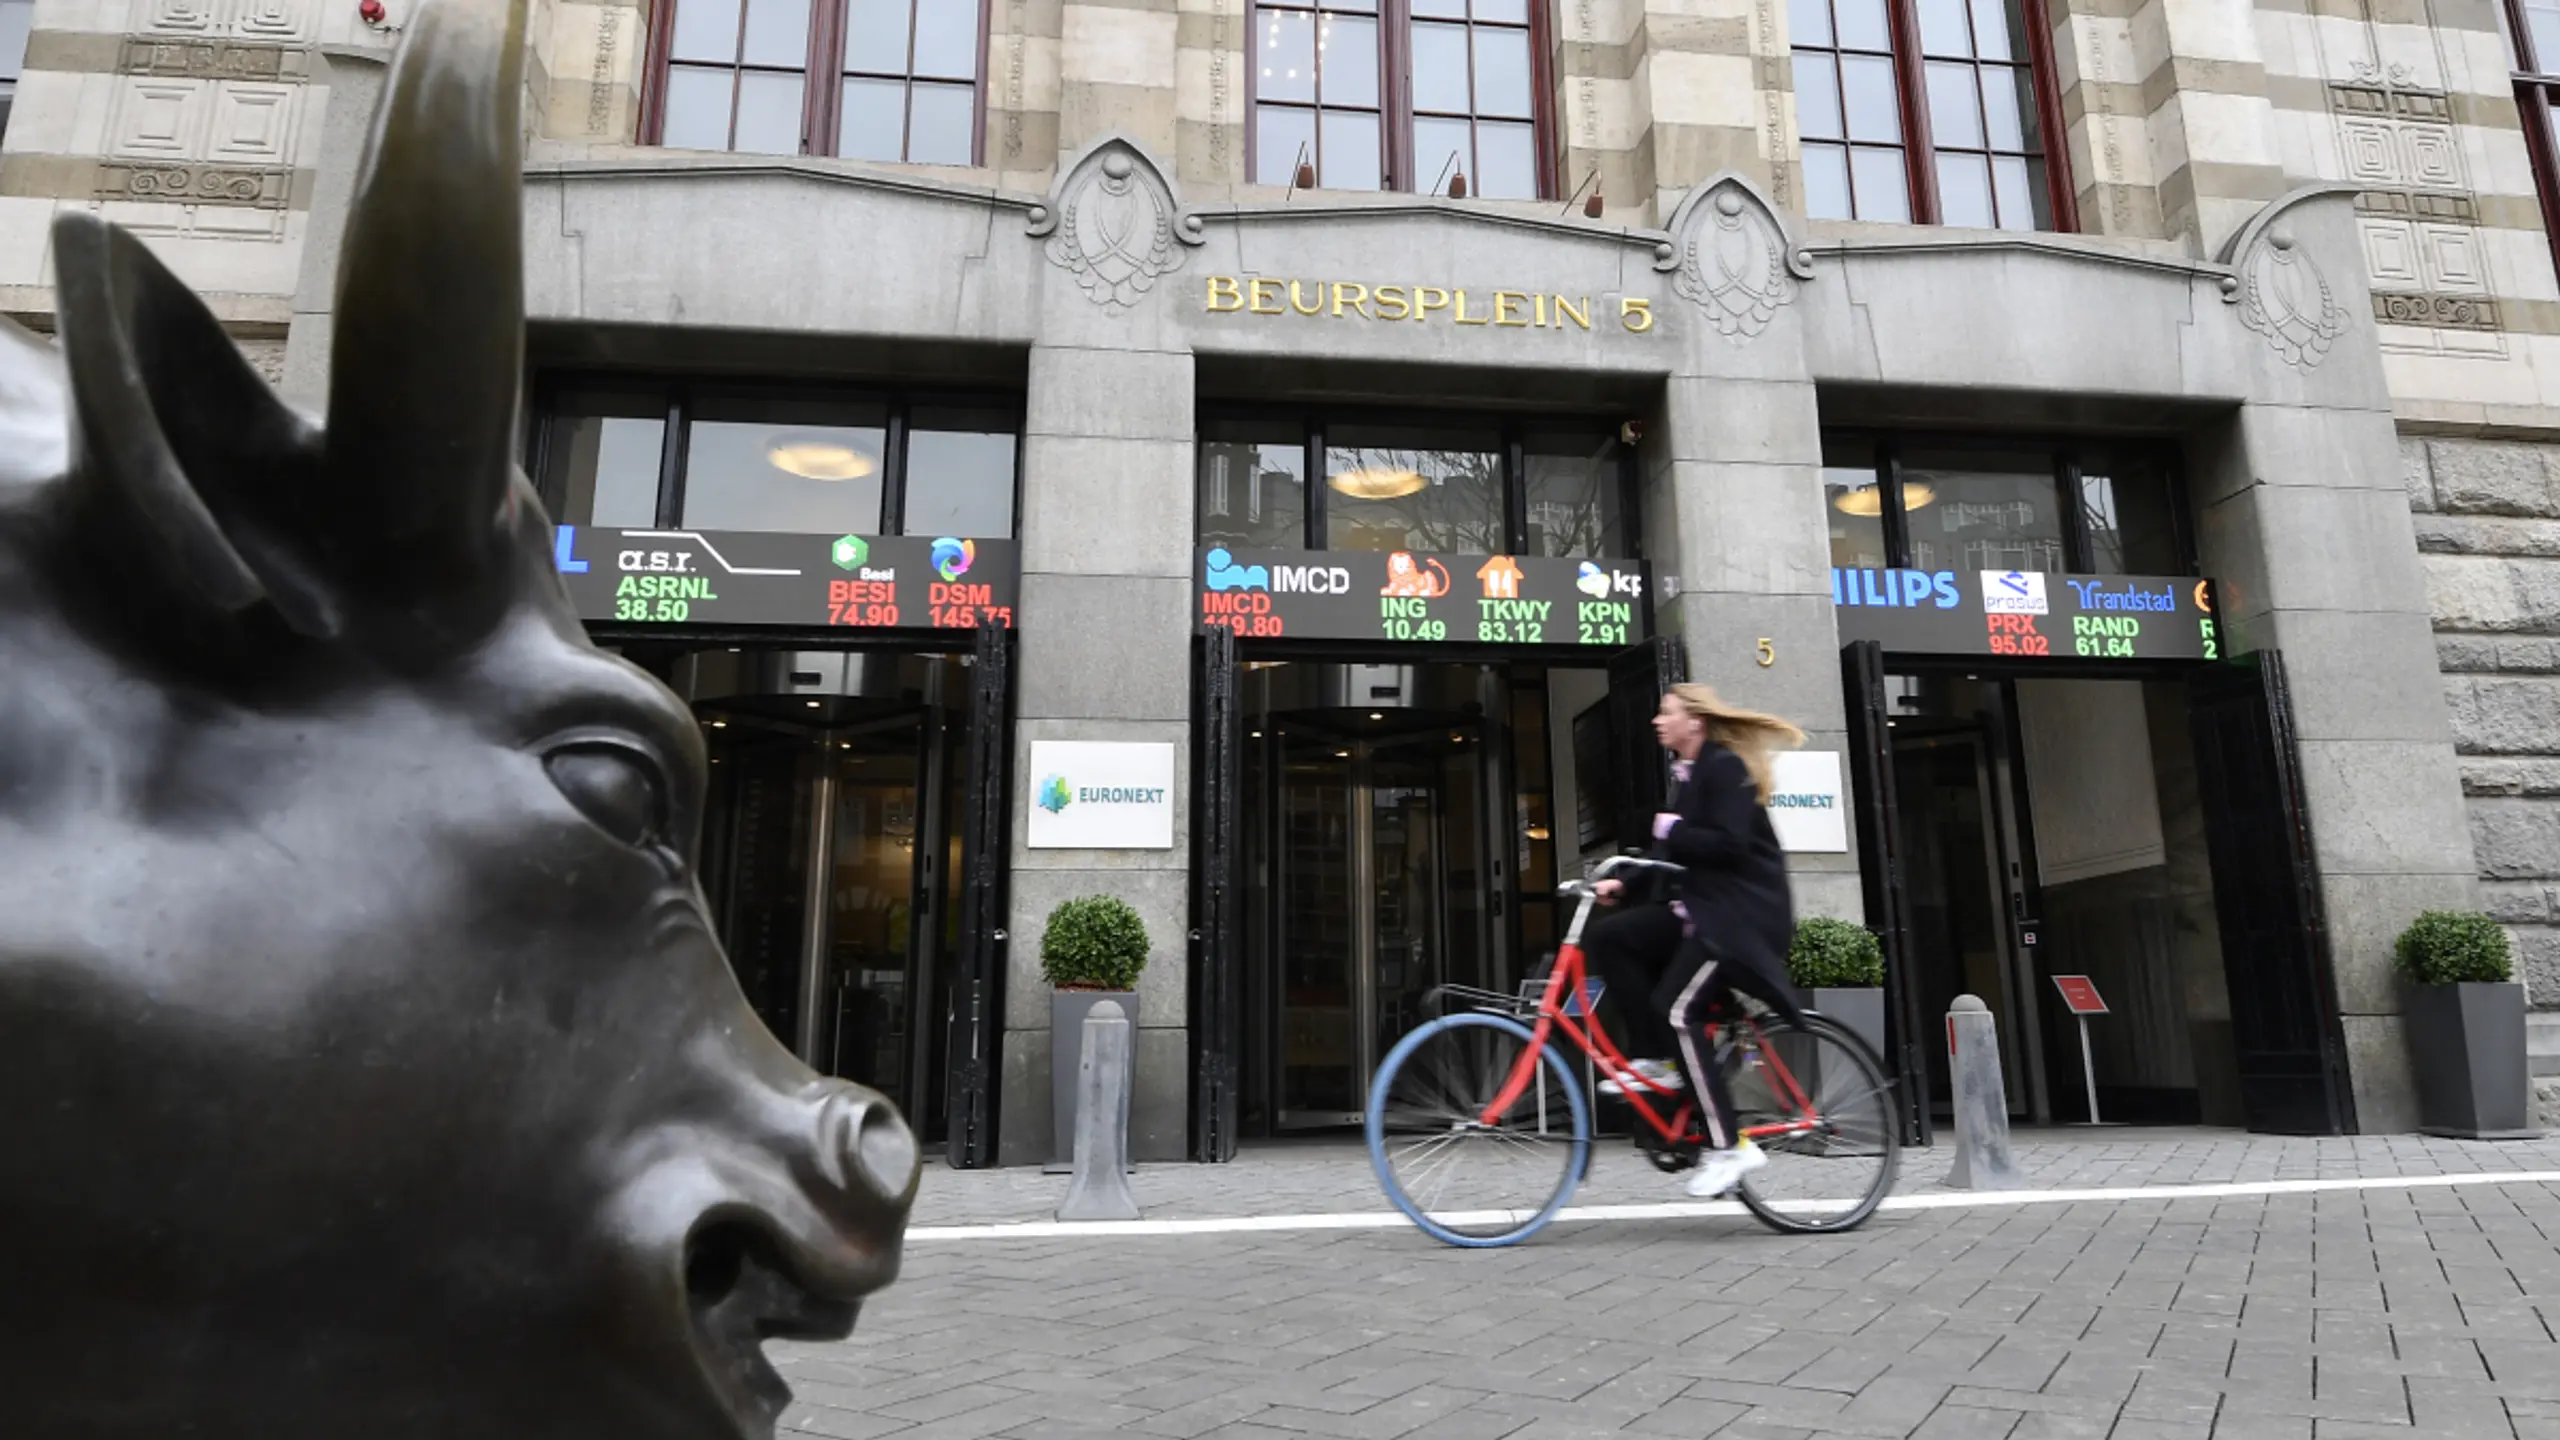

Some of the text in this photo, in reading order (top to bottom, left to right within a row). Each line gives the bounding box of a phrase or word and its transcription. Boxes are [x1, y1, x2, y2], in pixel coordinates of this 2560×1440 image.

[1205, 276, 1654, 332] BEURSPLEIN 5
[618, 550, 697, 572] a.s.r.
[615, 575, 718, 600] ASRNL
[1273, 565, 1350, 594] IMCD
[829, 580, 896, 603] BESI
[929, 583, 992, 605] DSM
[615, 598, 689, 622] 38.50
[1203, 592, 1272, 614] IMCD
[1380, 597, 1427, 618] ING
[1477, 600, 1552, 621] TKWY
[1578, 602, 1631, 623] KPN
[828, 603, 899, 627] 74.90
[1986, 614, 2037, 635] PRX
[1382, 619, 1446, 640] 10.49
[1478, 621, 1543, 642] 83.12
[1579, 623, 1627, 645] 2.91
[2073, 616, 2140, 637] RAND
[1756, 638, 1775, 667] 5
[1988, 635, 2050, 656] 95.02
[2075, 637, 2135, 657] 61.64
[2203, 640, 2218, 660] 2
[1079, 787, 1165, 803] EURONEXT
[1767, 794, 1834, 809] URONEXT
